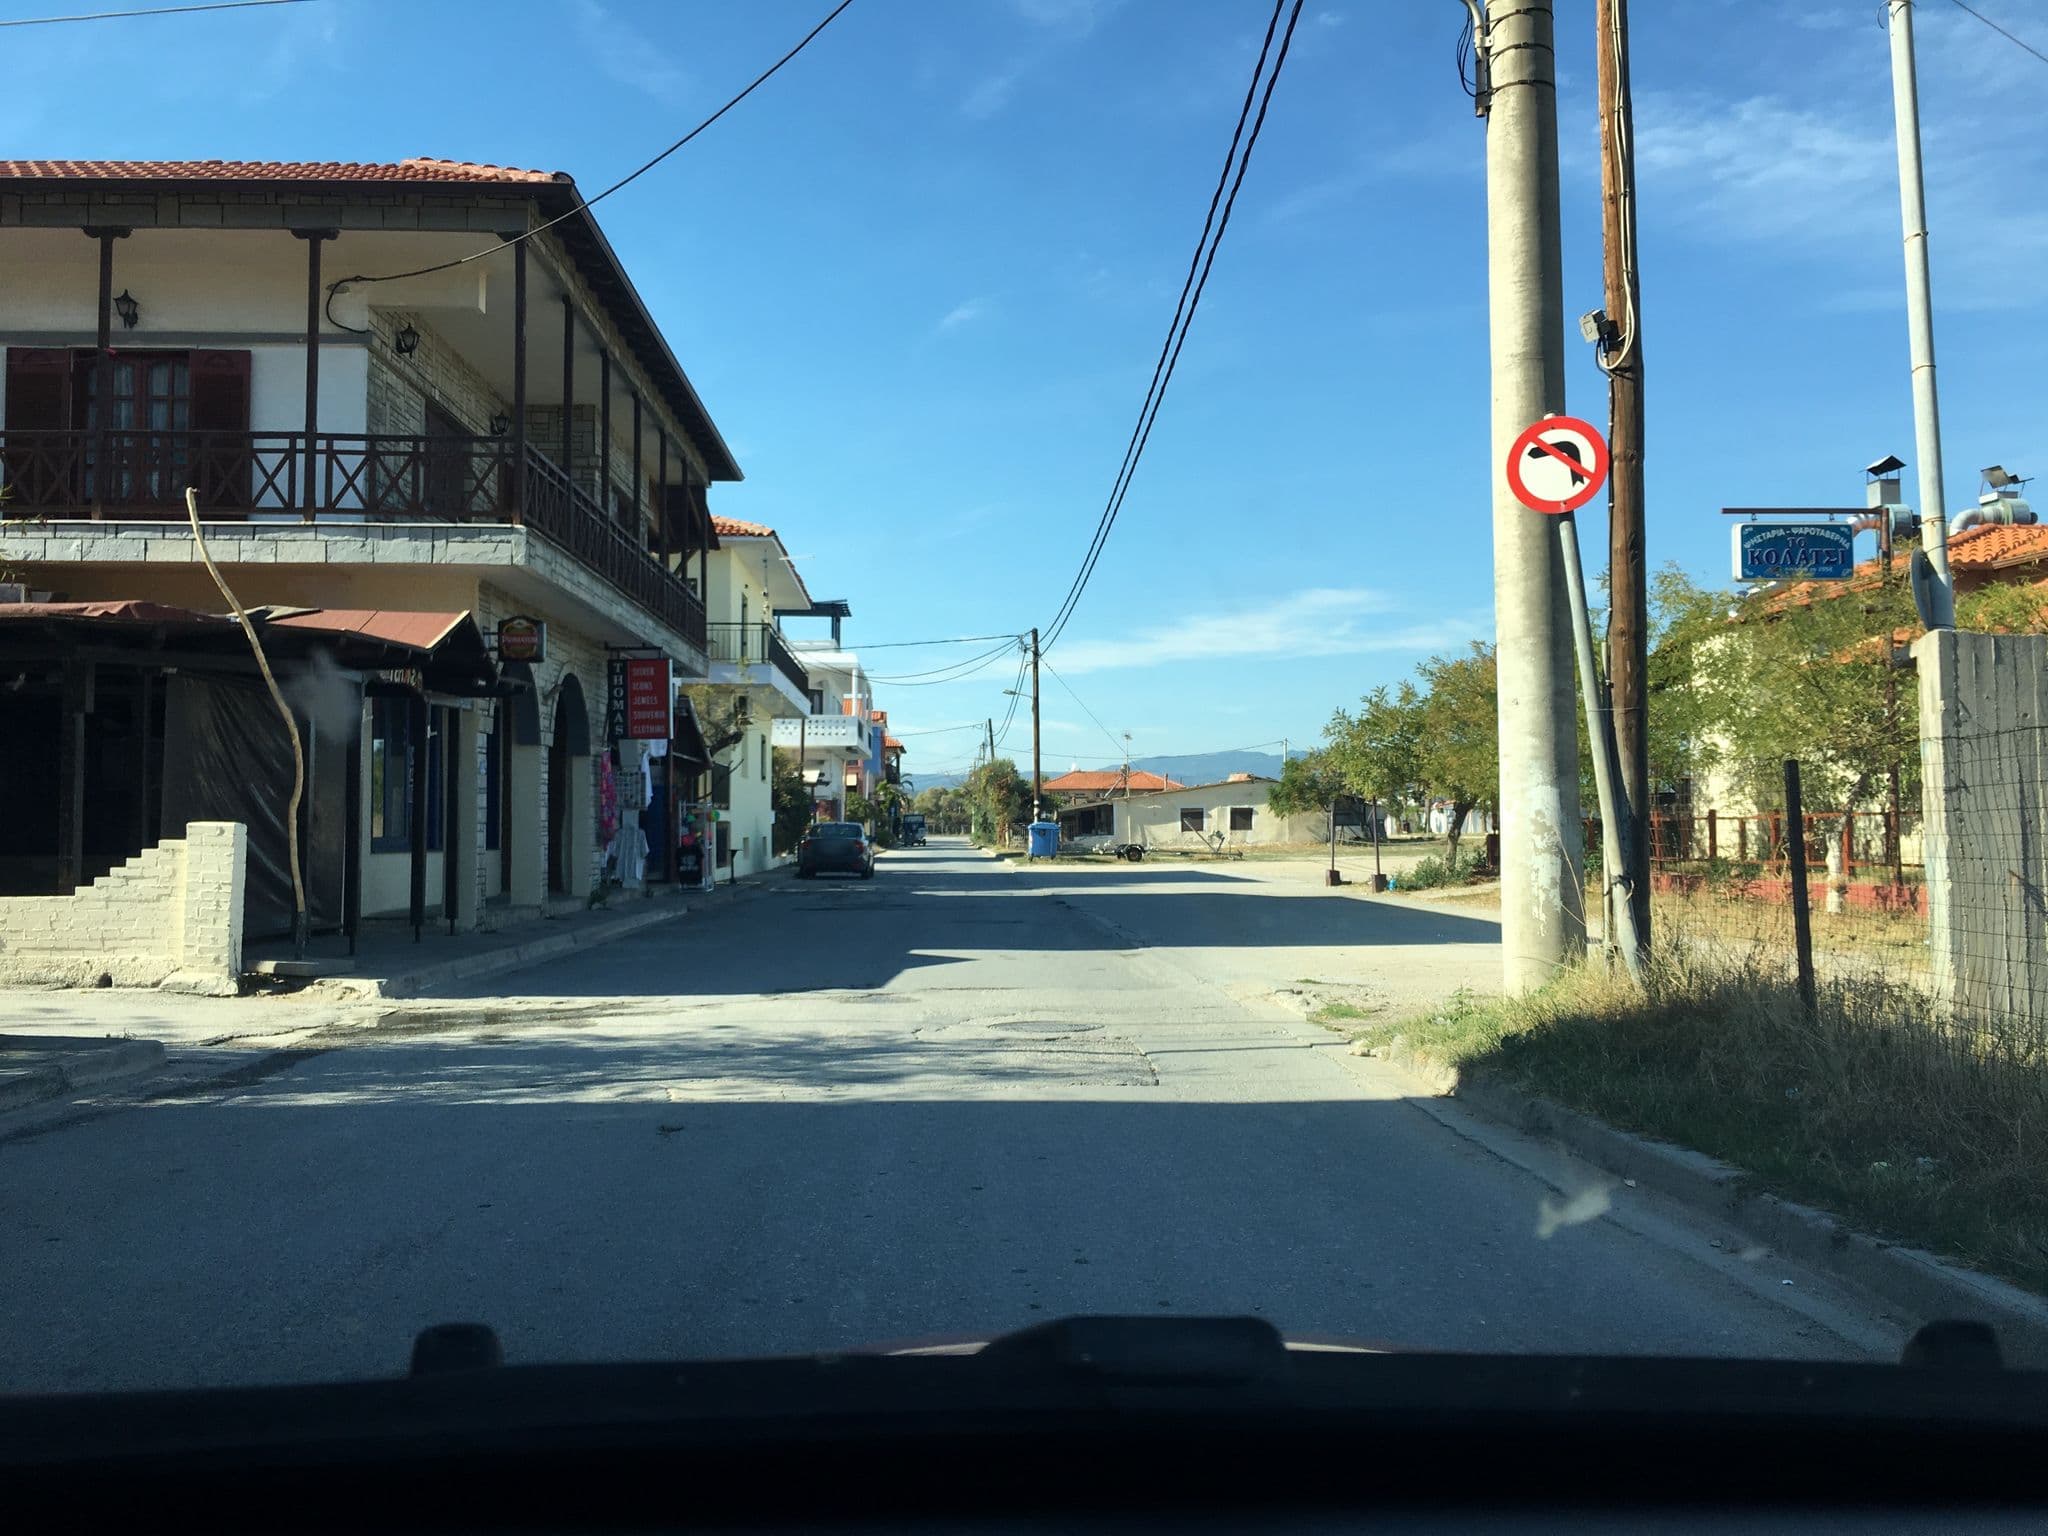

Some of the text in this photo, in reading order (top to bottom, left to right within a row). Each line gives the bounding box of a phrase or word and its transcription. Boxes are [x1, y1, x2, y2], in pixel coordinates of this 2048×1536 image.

[1743, 528, 1786, 549] ΨΗΣΤΑΡΙΑ
[1791, 527, 1850, 550] ΨΑΡΟΤΑΒΕΡΝΑ
[1787, 536, 1807, 548] ΤΟ
[612, 662, 624, 736] THOMAS
[632, 695, 658, 705] JEWELS
[632, 724, 665, 734] CLOTHING
